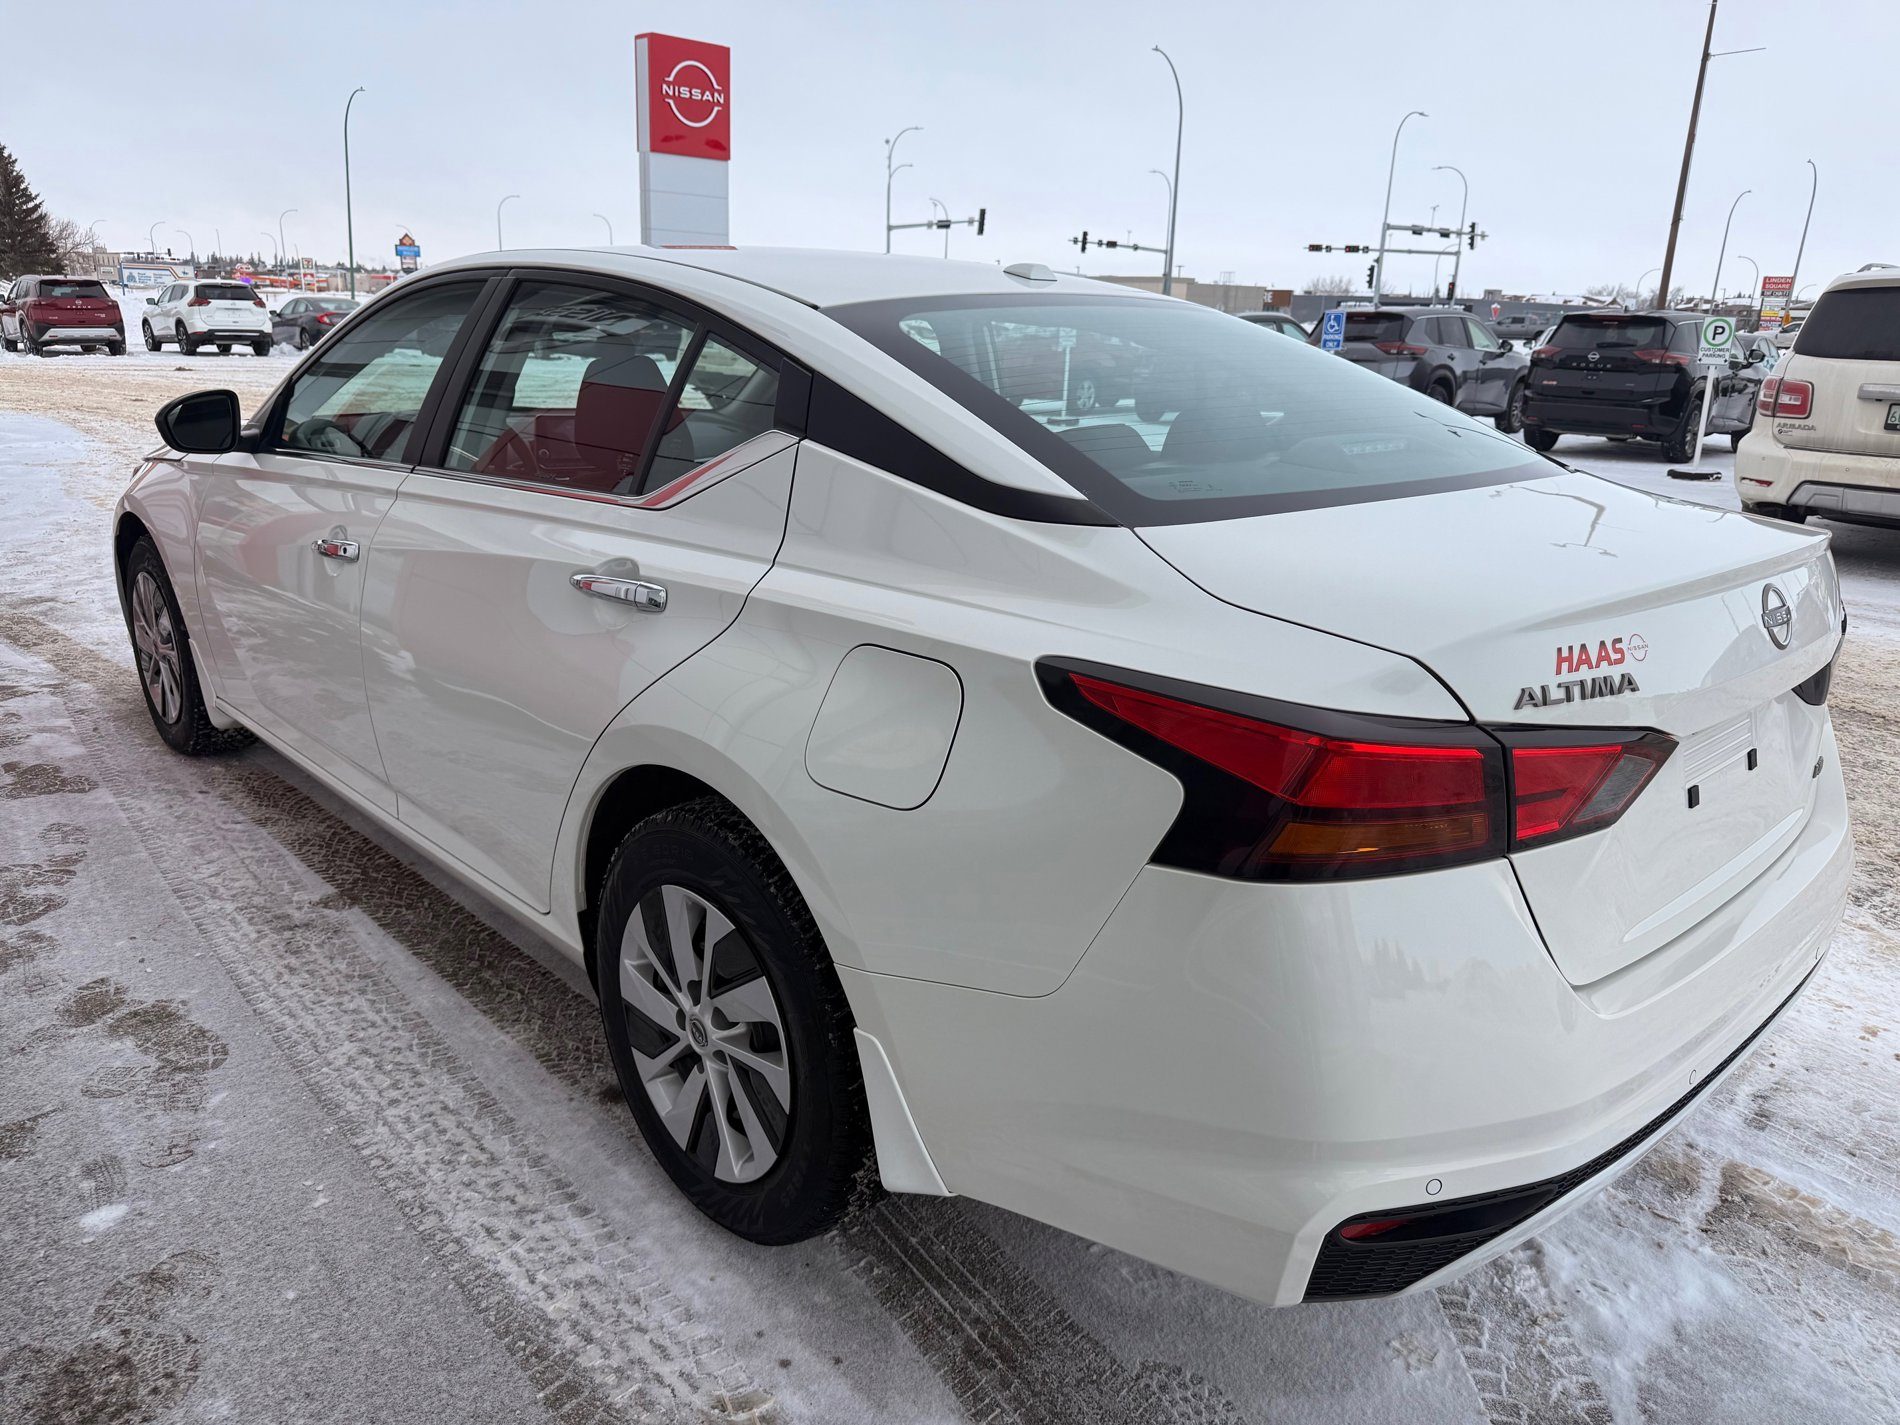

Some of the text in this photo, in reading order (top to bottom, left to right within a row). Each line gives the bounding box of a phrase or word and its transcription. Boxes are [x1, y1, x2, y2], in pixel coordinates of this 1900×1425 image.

[662, 83, 724, 104] NISSAN
[1712, 325, 1726, 341] P
[1890, 410, 1900, 423] 6
[1776, 422, 1817, 432] ARMADA
[1555, 637, 1649, 676] HAAS NISSAN
[1513, 672, 1640, 710] ALTIMA
